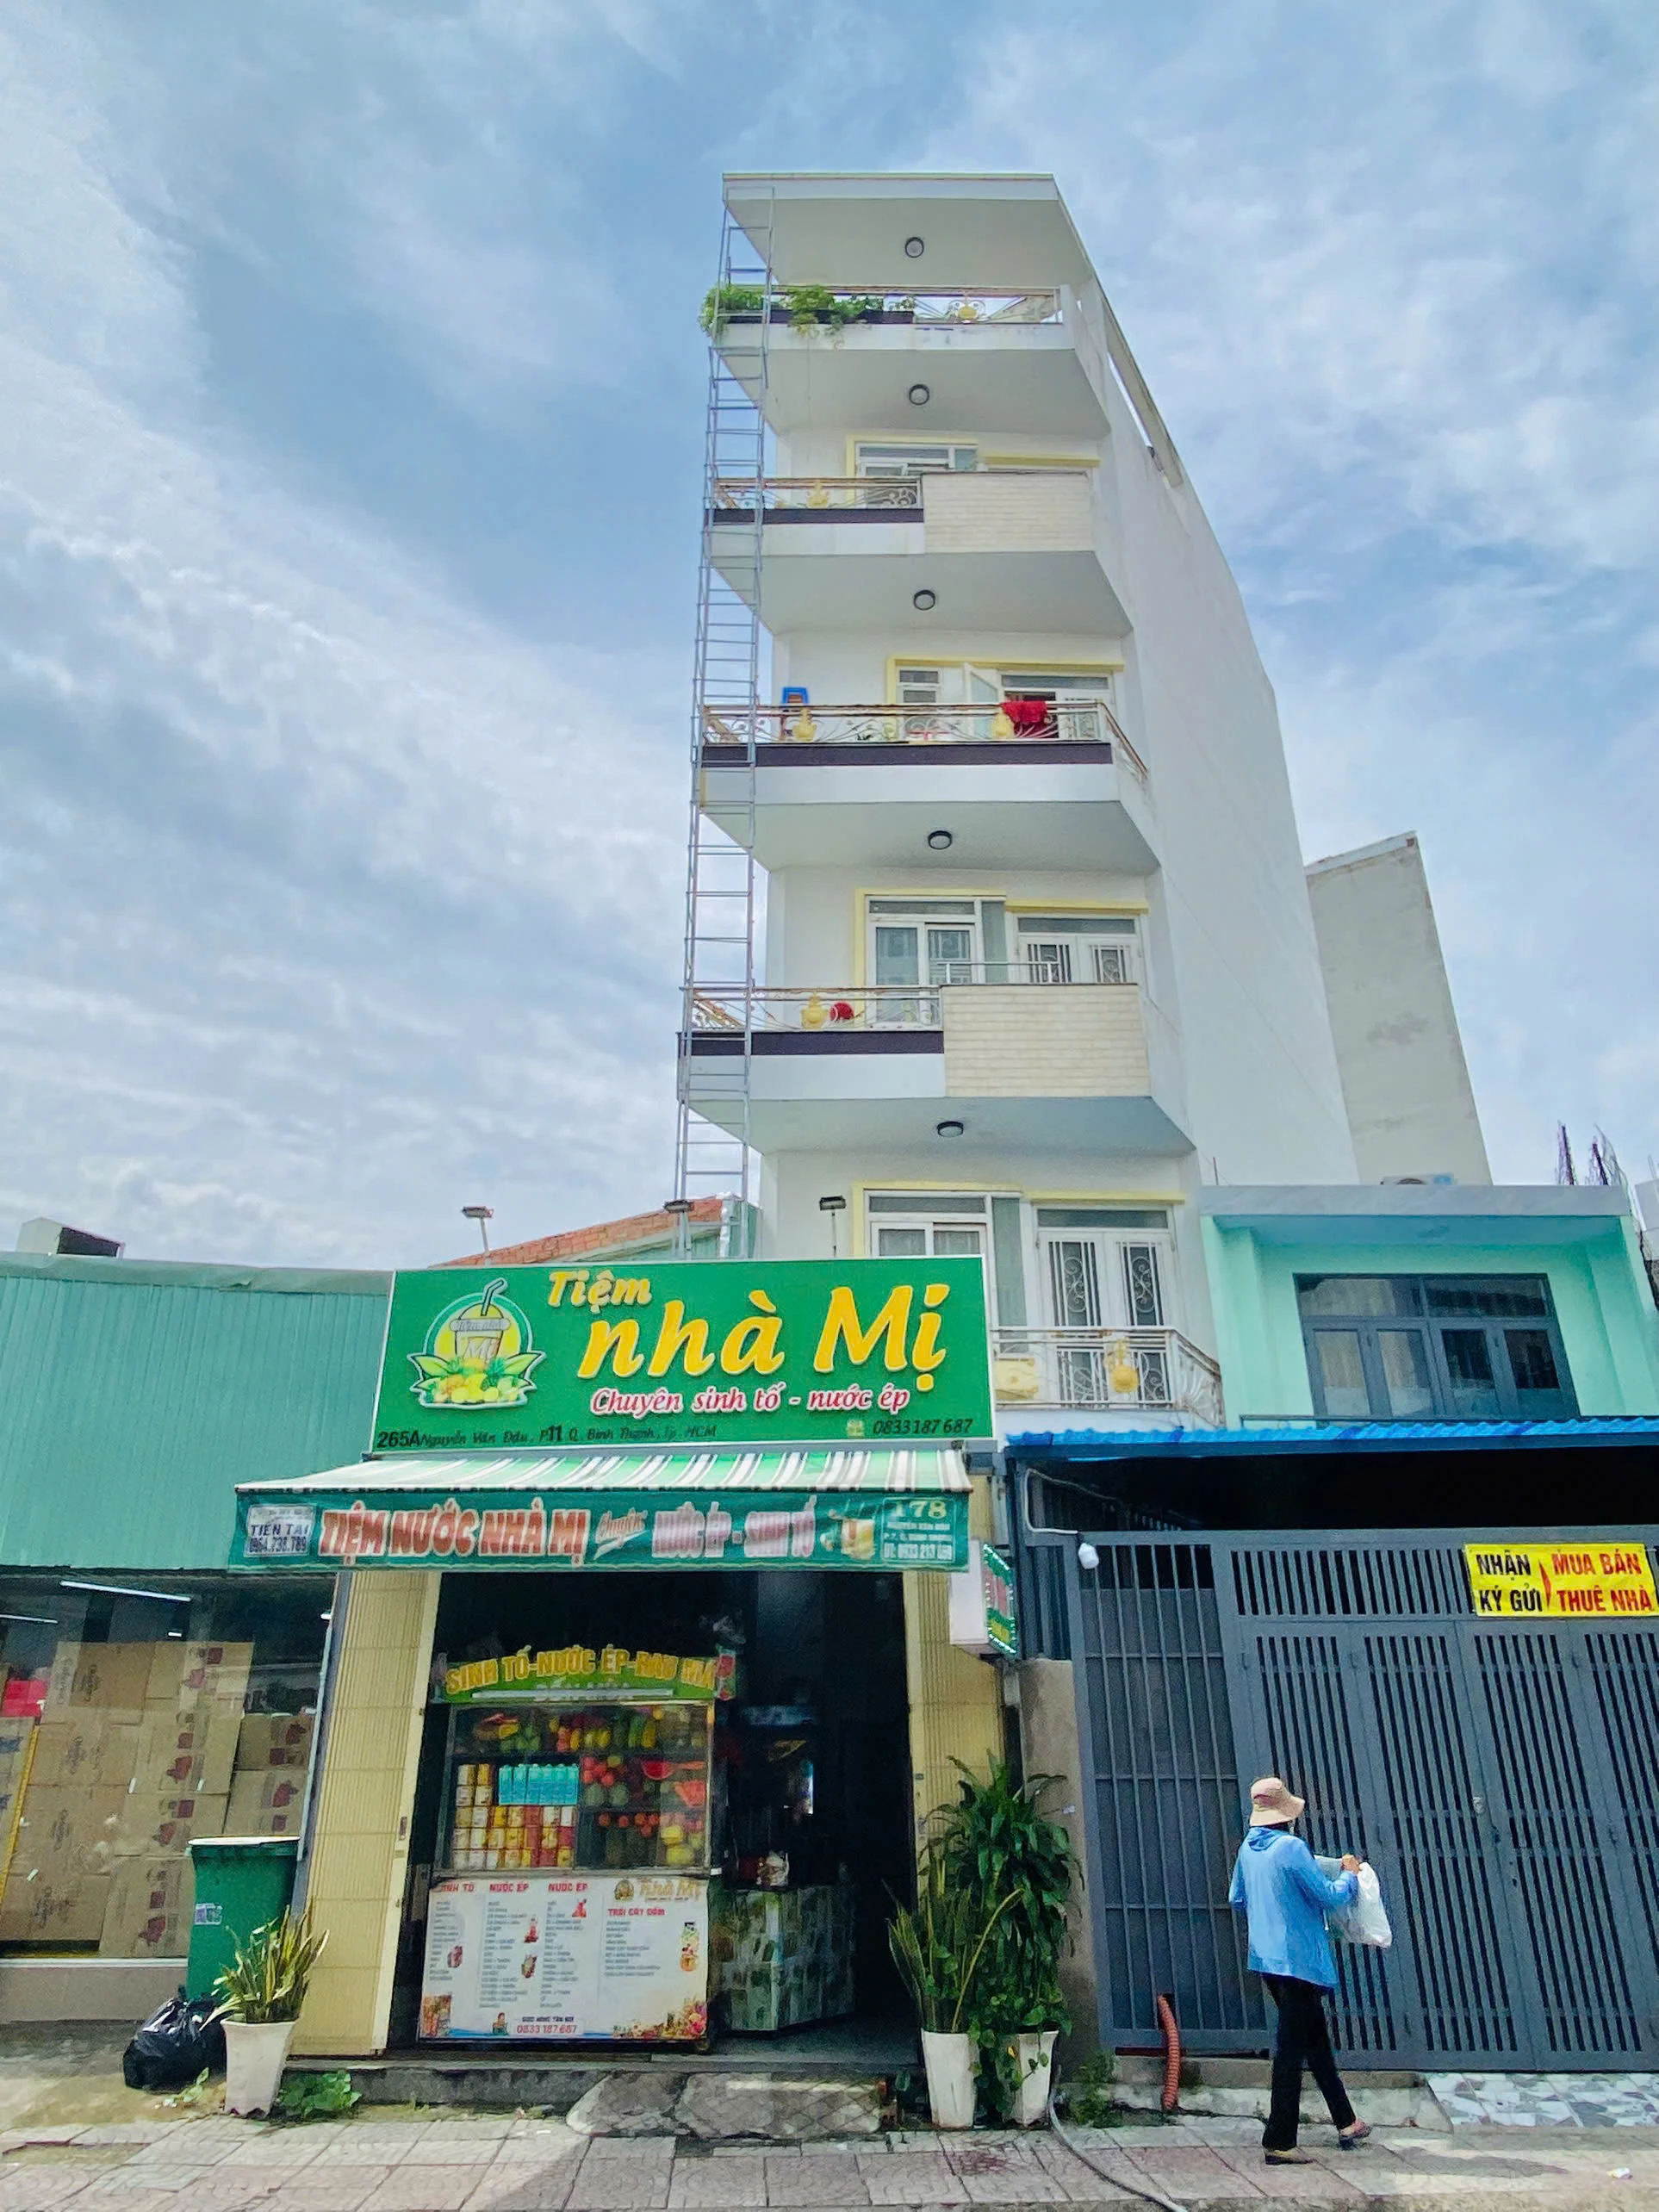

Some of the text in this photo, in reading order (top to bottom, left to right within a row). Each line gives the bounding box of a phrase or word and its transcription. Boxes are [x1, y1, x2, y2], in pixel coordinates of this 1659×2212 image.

[548, 1270, 652, 1314] Tiệm
[577, 1283, 950, 1392] nhà Mị
[591, 1388, 683, 1420] Chuyên
[692, 1385, 746, 1413] sinh
[753, 1382, 786, 1411] tố
[806, 1383, 872, 1412] nước
[878, 1383, 910, 1414] ép
[377, 1429, 419, 1448] 265A
[318, 1501, 389, 1565] TIỆM
[388, 1497, 479, 1556] NƯỚC
[479, 1497, 547, 1556] NHÀ
[548, 1508, 591, 1568] MỊ
[1476, 1550, 1532, 1581] NHẬN
[1551, 1549, 1642, 1575] MUA BÁN
[1478, 1582, 1543, 1612] KÝ GỬI
[1556, 1585, 1655, 1612] THUÊ NHÀ
